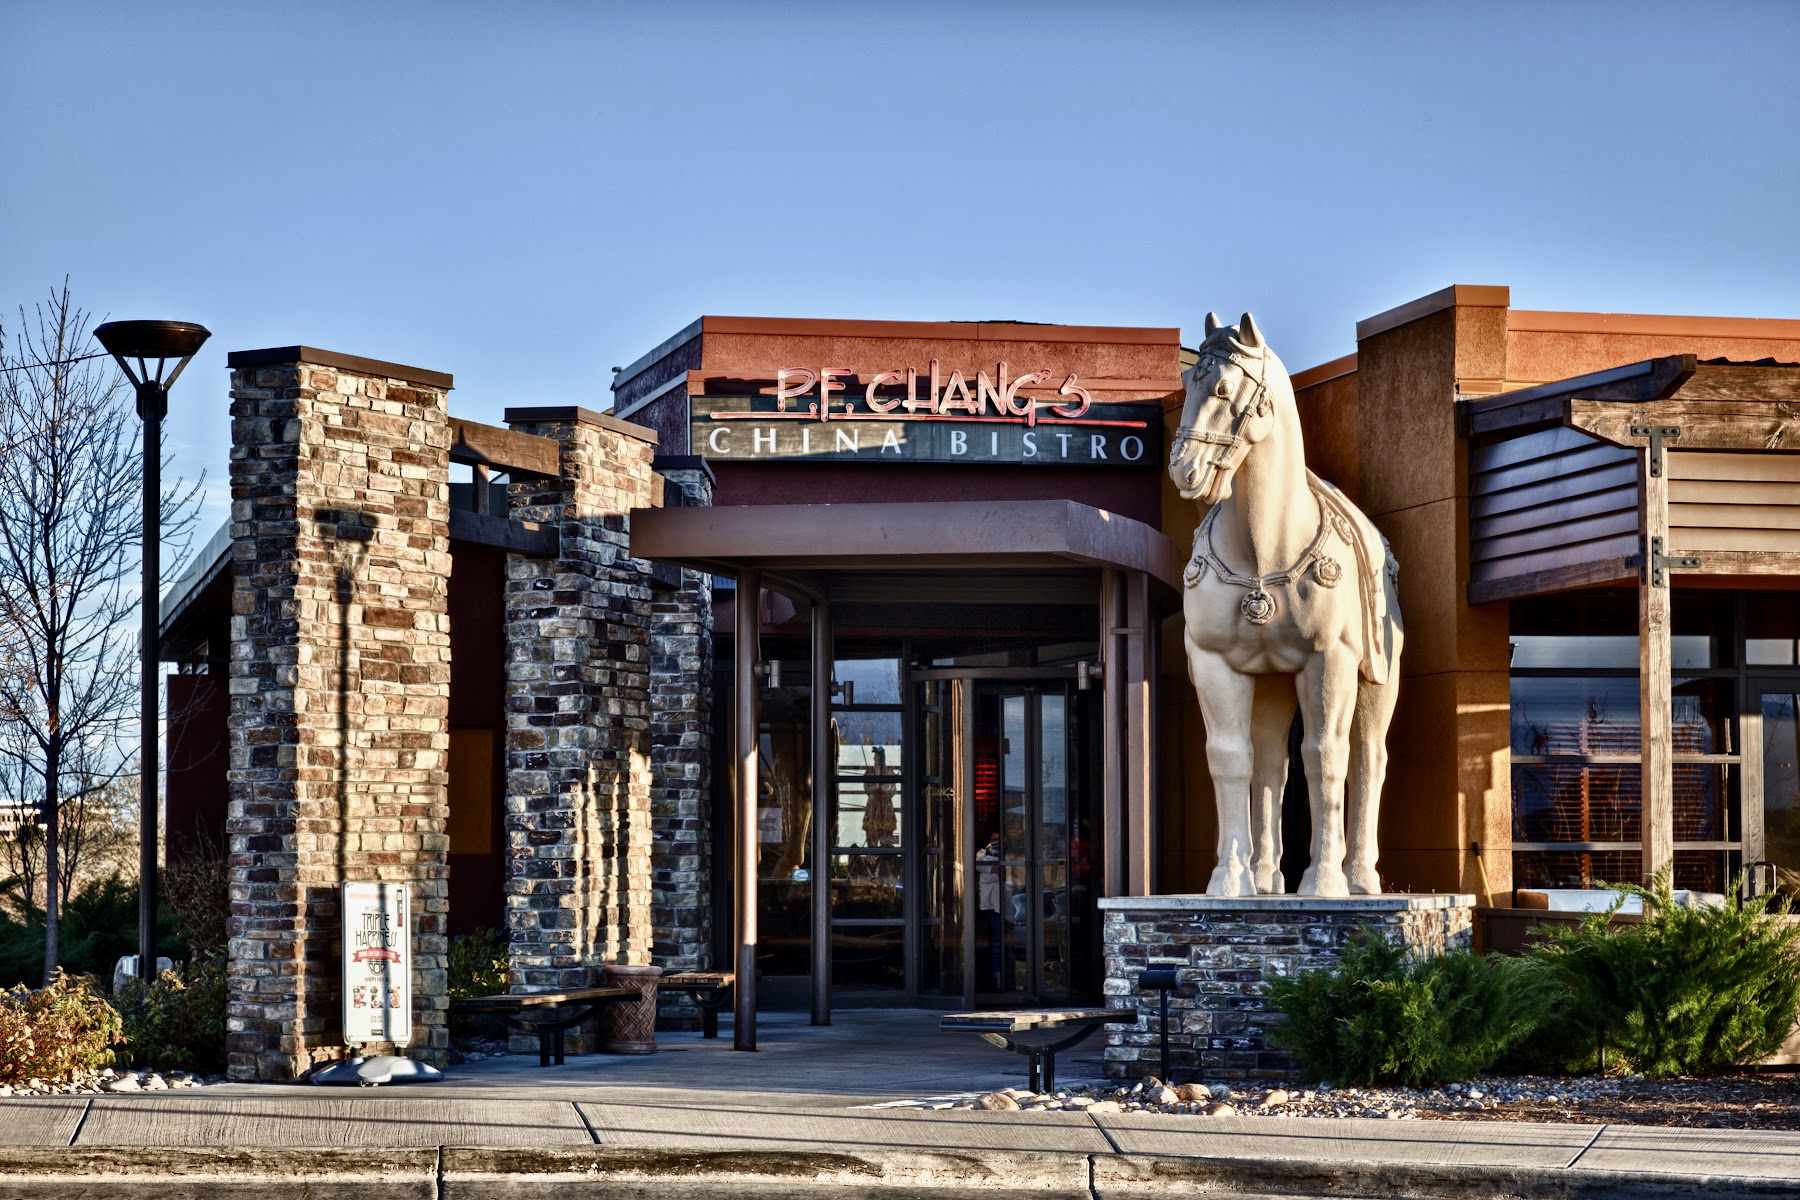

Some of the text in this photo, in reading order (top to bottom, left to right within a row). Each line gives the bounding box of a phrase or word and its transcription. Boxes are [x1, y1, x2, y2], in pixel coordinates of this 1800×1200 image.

[865, 358, 1092, 427] CHANG'S
[708, 427, 1146, 461] CHINA BISTRO
[361, 913, 390, 931] TRIPLE
[355, 930, 398, 947] HAPPINESS
